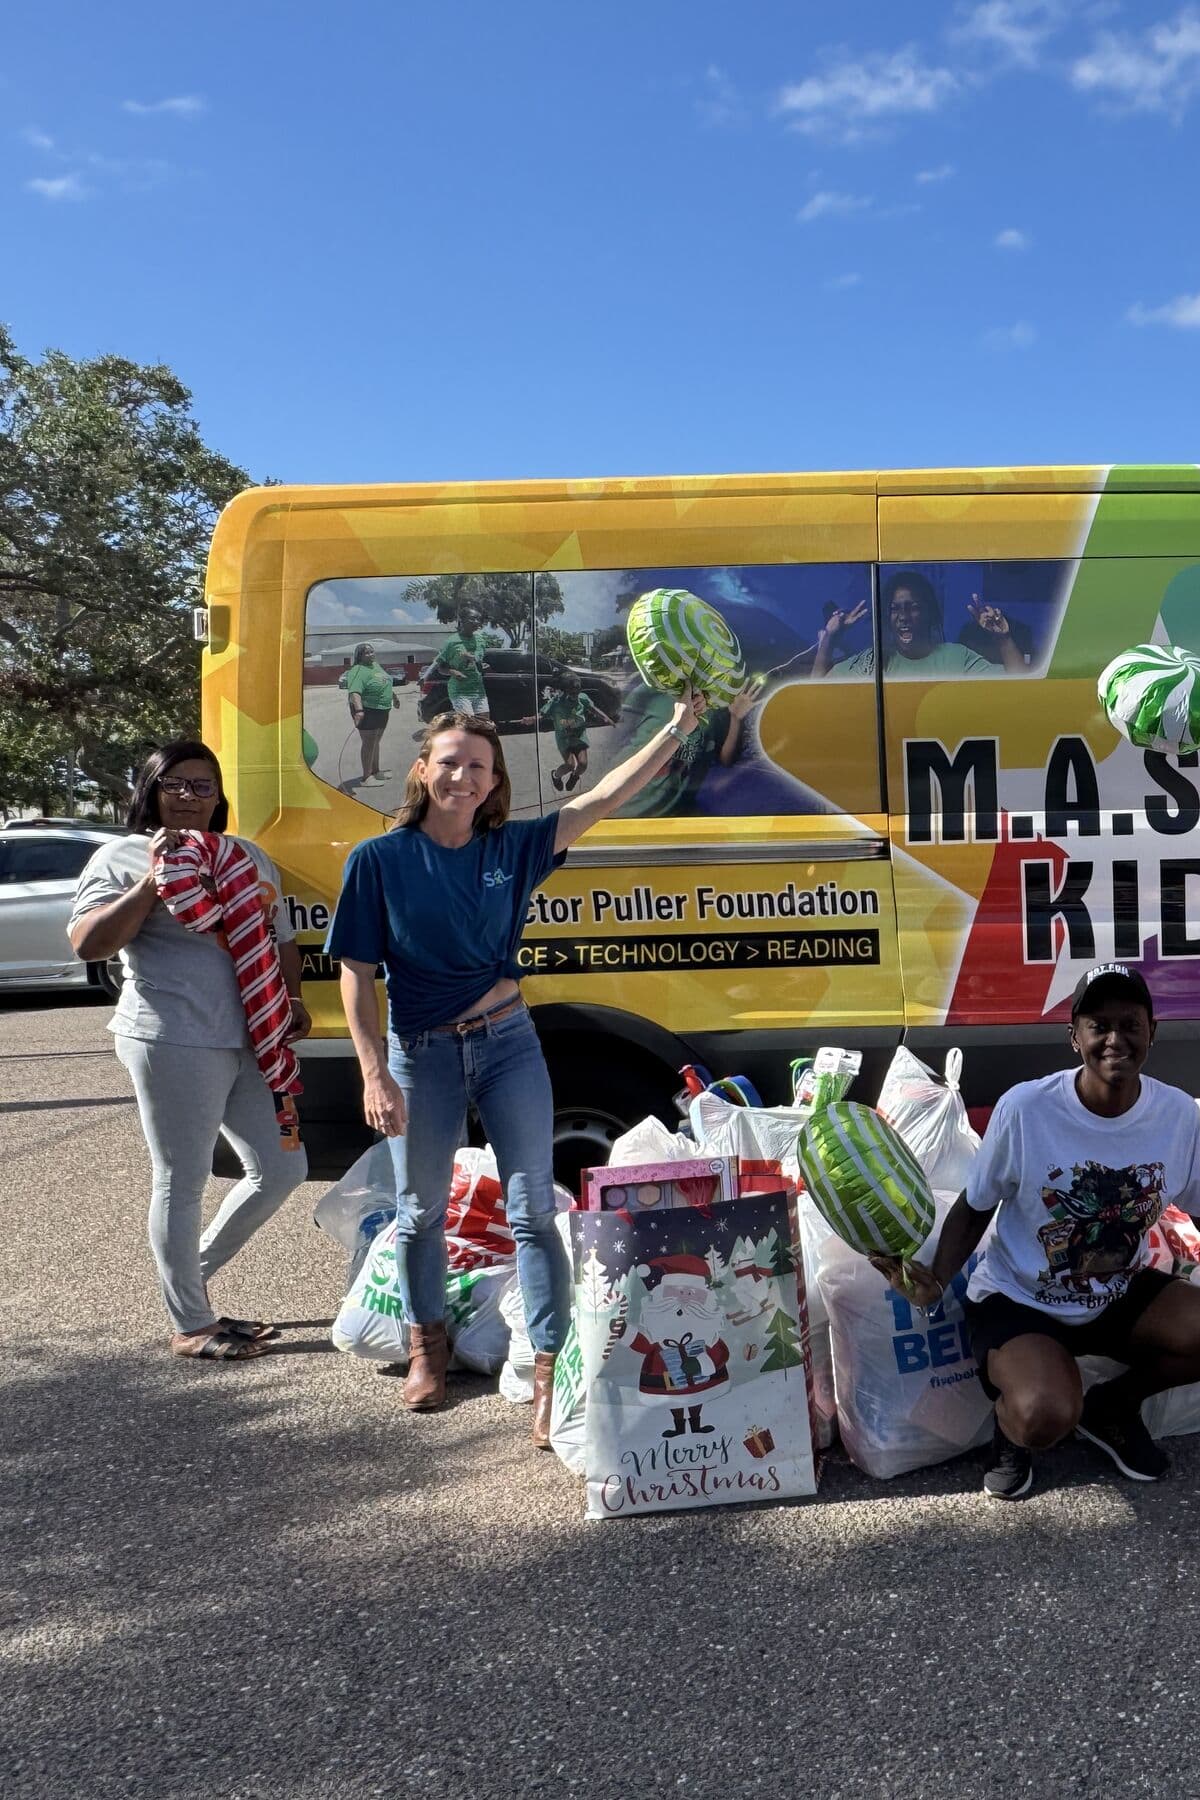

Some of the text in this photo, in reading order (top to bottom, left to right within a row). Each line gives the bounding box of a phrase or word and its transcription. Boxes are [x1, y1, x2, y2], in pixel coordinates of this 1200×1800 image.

[284, 896, 330, 930] he
[592, 888, 688, 923] Puller
[696, 882, 879, 919] Foundation
[302, 953, 341, 974] ATH
[574, 940, 740, 966] TECHNOLOGY
[767, 937, 873, 961] READING
[621, 1434, 733, 1477] Merry
[602, 1464, 780, 1511] Christmas
